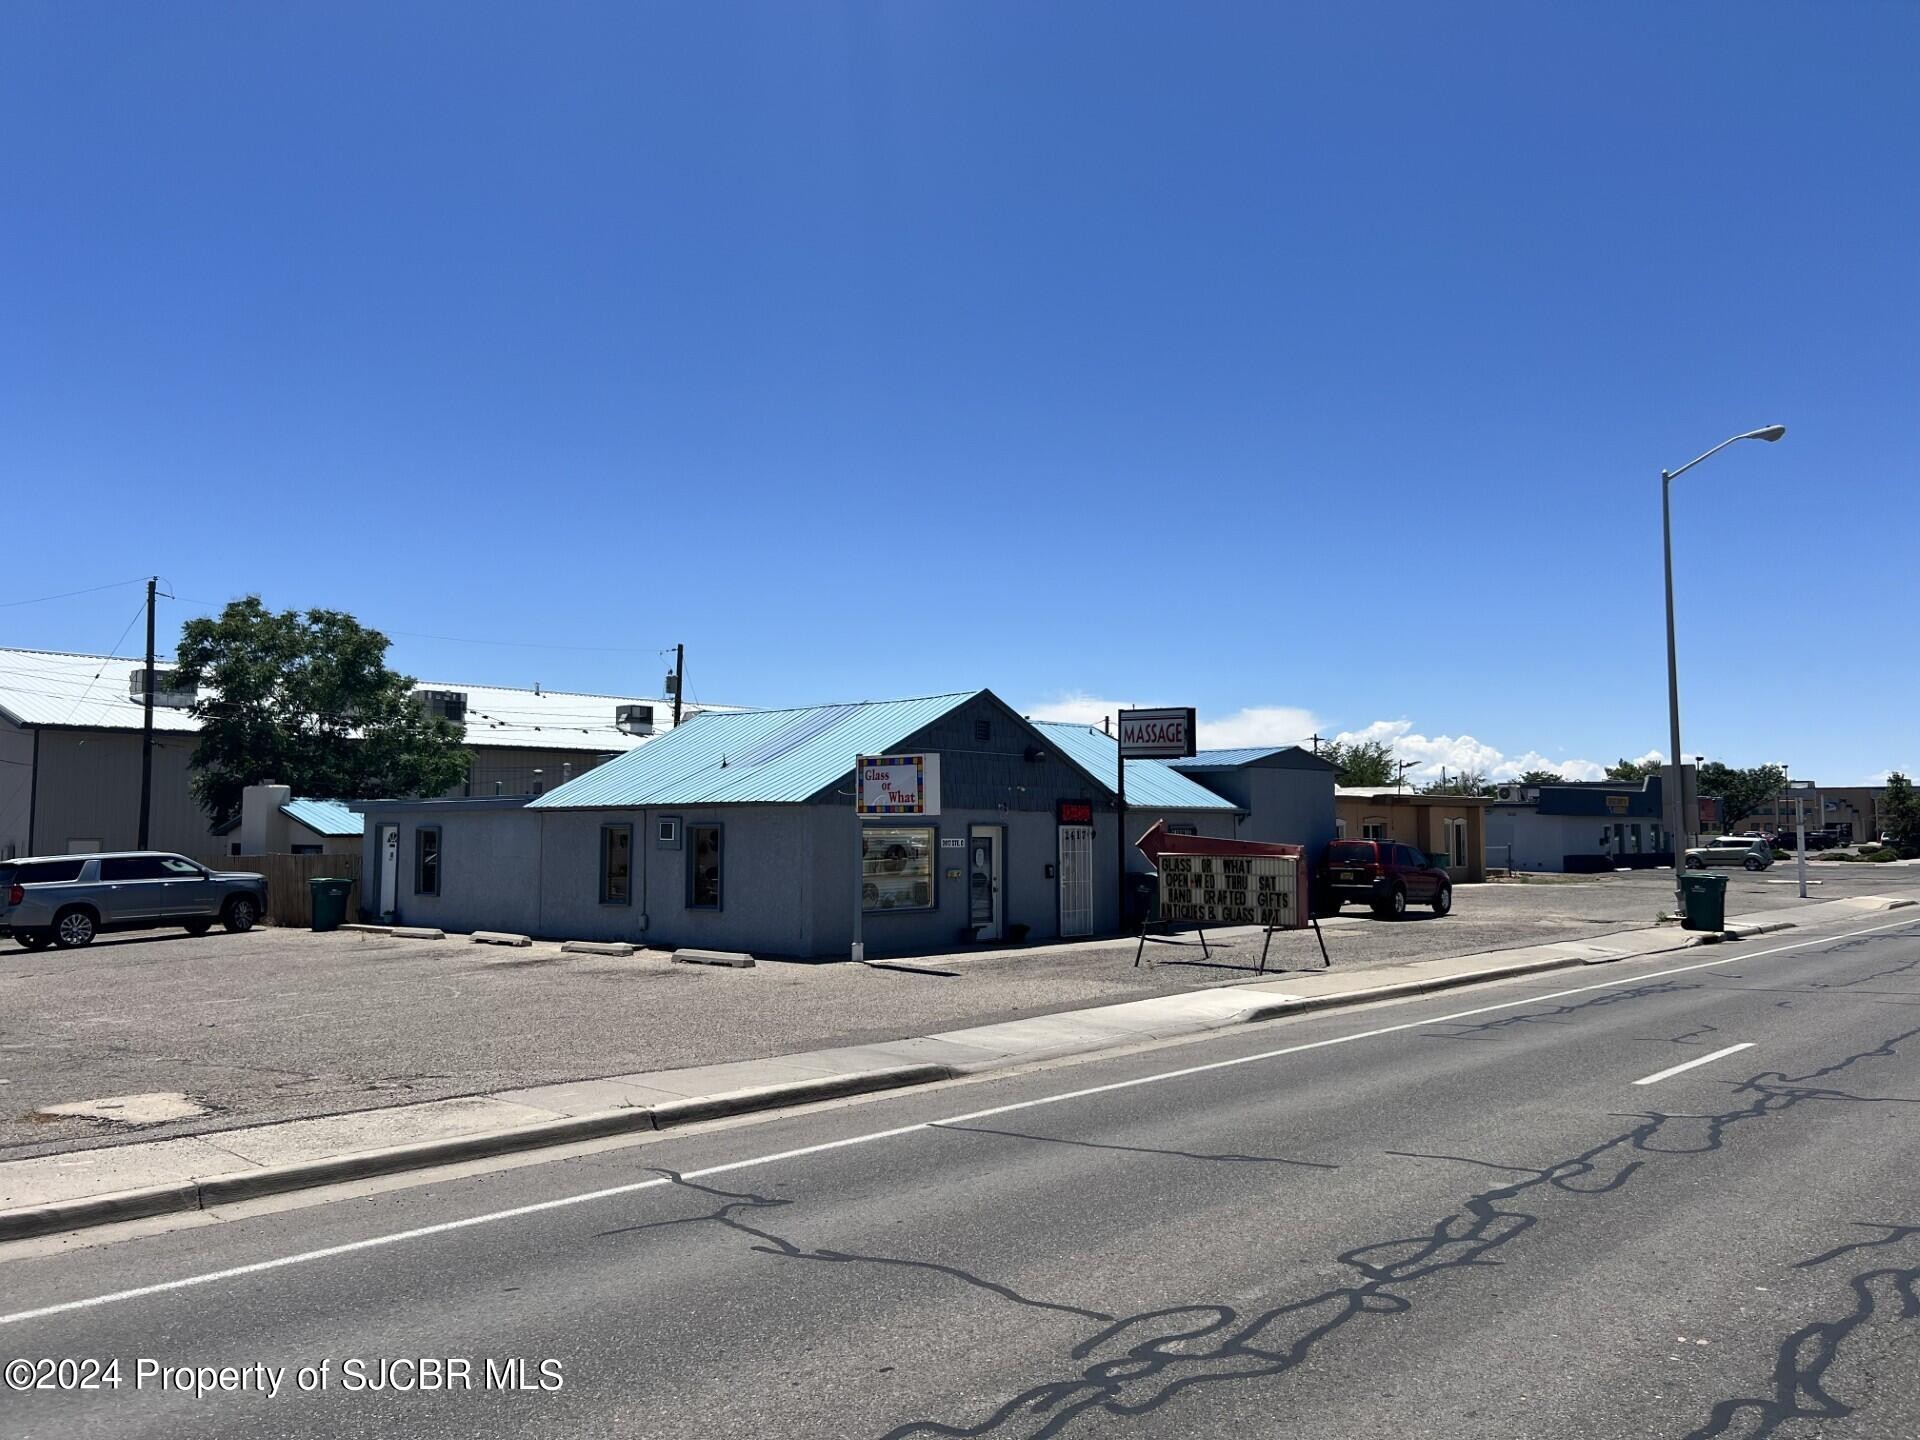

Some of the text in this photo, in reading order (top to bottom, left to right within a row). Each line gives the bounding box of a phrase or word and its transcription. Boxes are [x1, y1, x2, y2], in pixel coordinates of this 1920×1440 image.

[1123, 723, 1182, 744] MASSAGE
[865, 769, 890, 781] Glass
[881, 781, 892, 790] or
[888, 790, 916, 803] What
[1162, 858, 1252, 874] GLASS OR WHAT
[1165, 874, 1277, 891] OPEN WED THRU SAT
[1168, 889, 1192, 903] HAND
[1257, 892, 1288, 908] GIFTS
[1222, 907, 1255, 922] GLASS
